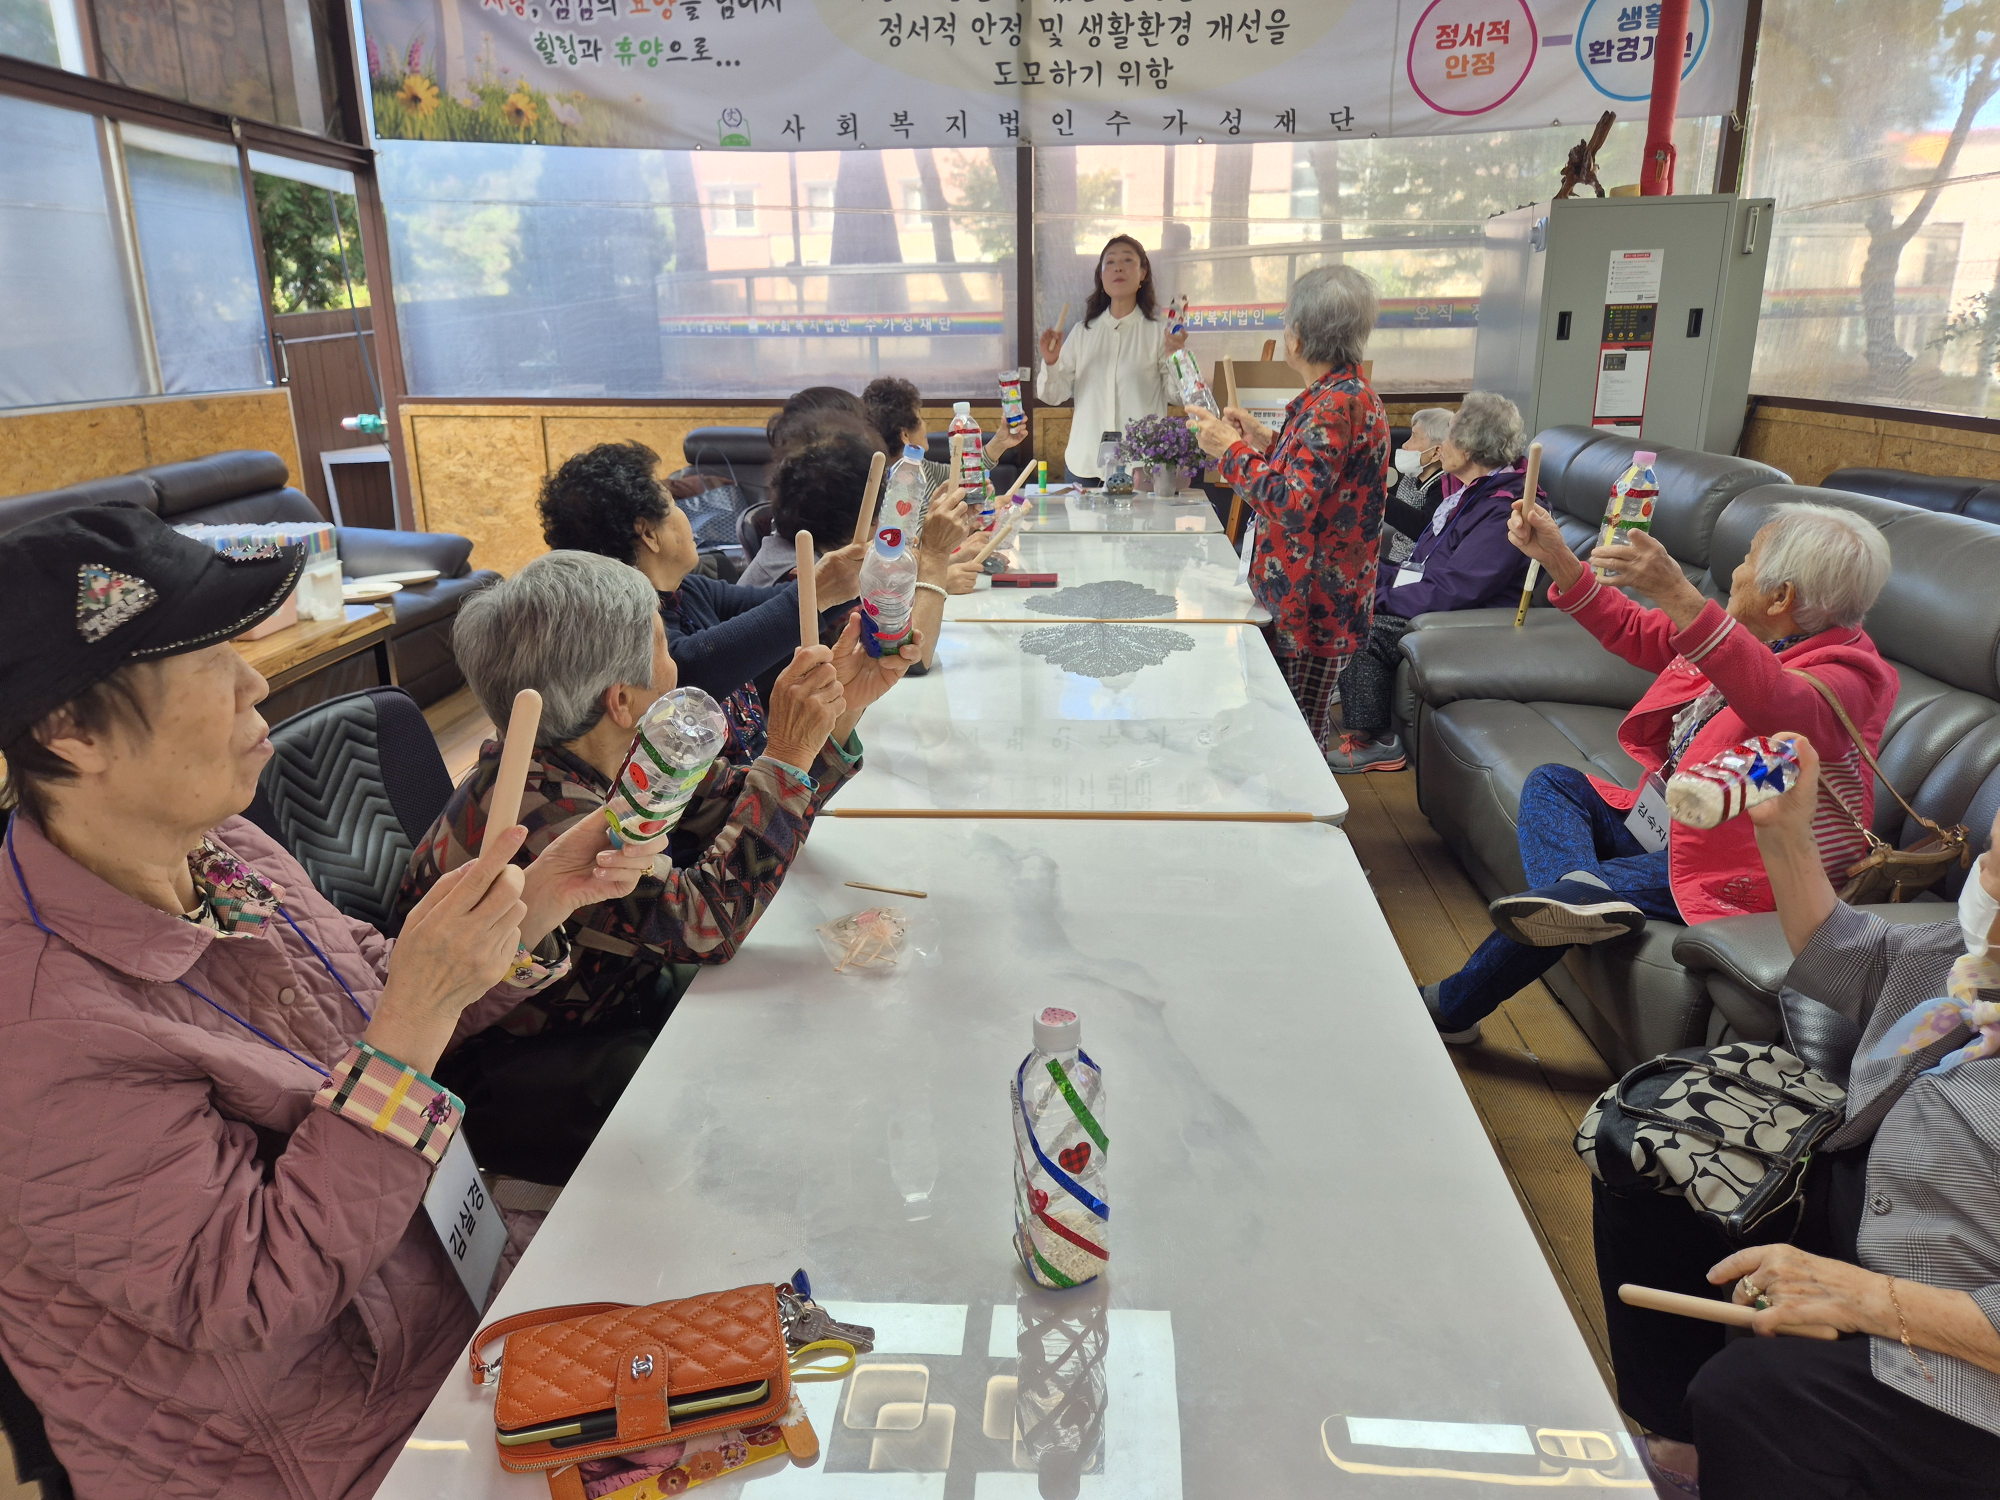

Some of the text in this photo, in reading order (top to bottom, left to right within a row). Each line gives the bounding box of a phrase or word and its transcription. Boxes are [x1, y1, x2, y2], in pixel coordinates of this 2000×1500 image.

[878, 9, 1291, 50] 정서적 안정 및 생활환경 개선을
[1435, 20, 1510, 50] 정서적
[534, 31, 741, 68] 힐링과 휴양으로...
[1445, 52, 1496, 80] 안정
[993, 57, 1174, 90] 도모하기 위함
[765, 319, 850, 334] 사회복지법인
[865, 317, 952, 333] 수가성재단
[449, 1177, 485, 1262] 김실경
